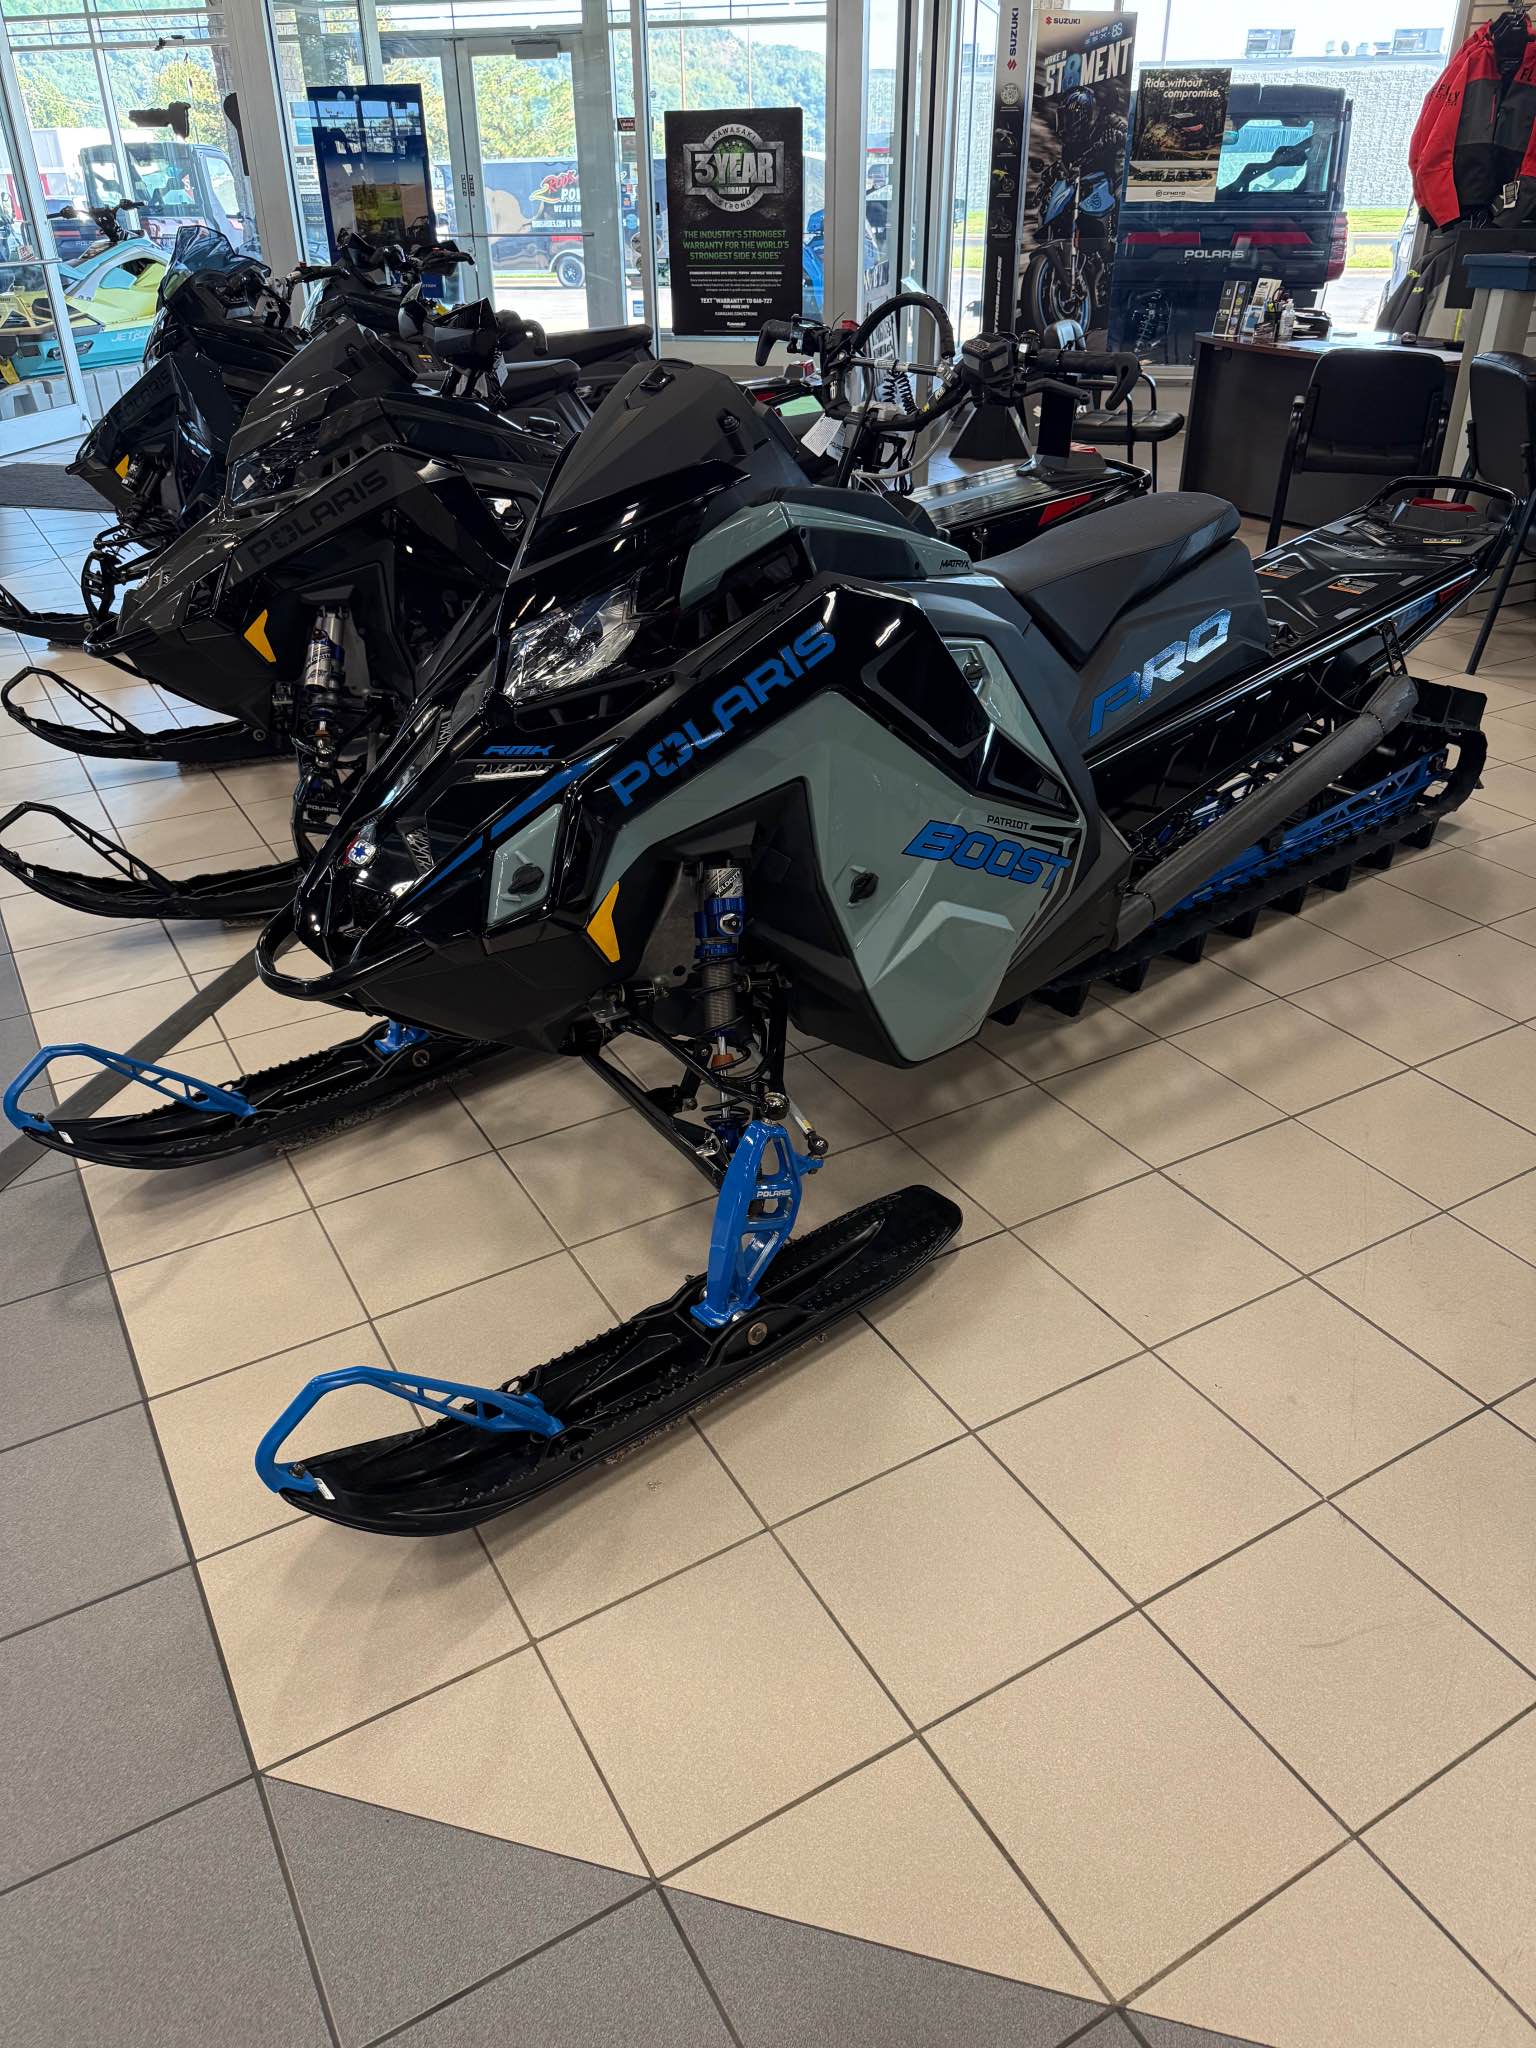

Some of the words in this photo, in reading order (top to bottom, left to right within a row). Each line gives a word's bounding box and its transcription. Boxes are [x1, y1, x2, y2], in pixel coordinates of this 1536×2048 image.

[1053, 17, 1081, 25] SUZUKI
[1009, 7, 1019, 56] SUZUKI
[1044, 37, 1134, 97] ST8MENT
[1144, 78, 1166, 89] Ride
[1167, 77, 1203, 88] without
[1163, 88, 1221, 100] compromise.
[711, 125, 757, 142] KAWASAKI
[684, 230, 699, 239] THE
[699, 230, 743, 239] INDUSTRY'S
[743, 230, 787, 238] STRONGEST
[682, 241, 724, 249] WARRANTY
[724, 241, 740, 249] FOR
[740, 241, 756, 249] THE
[756, 240, 790, 249] WORLD'S
[689, 252, 733, 260] STRONGEST
[733, 252, 752, 260] SIDE
[1183, 249, 1245, 259] POLARIS
[246, 466, 389, 566] POLARIS
[939, 559, 970, 570] MATRYX
[1088, 607, 1233, 740] PRO
[606, 621, 837, 808] POLARIS
[483, 744, 556, 757] RMK
[306, 804, 339, 813] POLARIS
[986, 814, 1031, 831] PATRIOT
[901, 818, 1073, 890] BOOST
[756, 1189, 792, 1199] POLARIS
